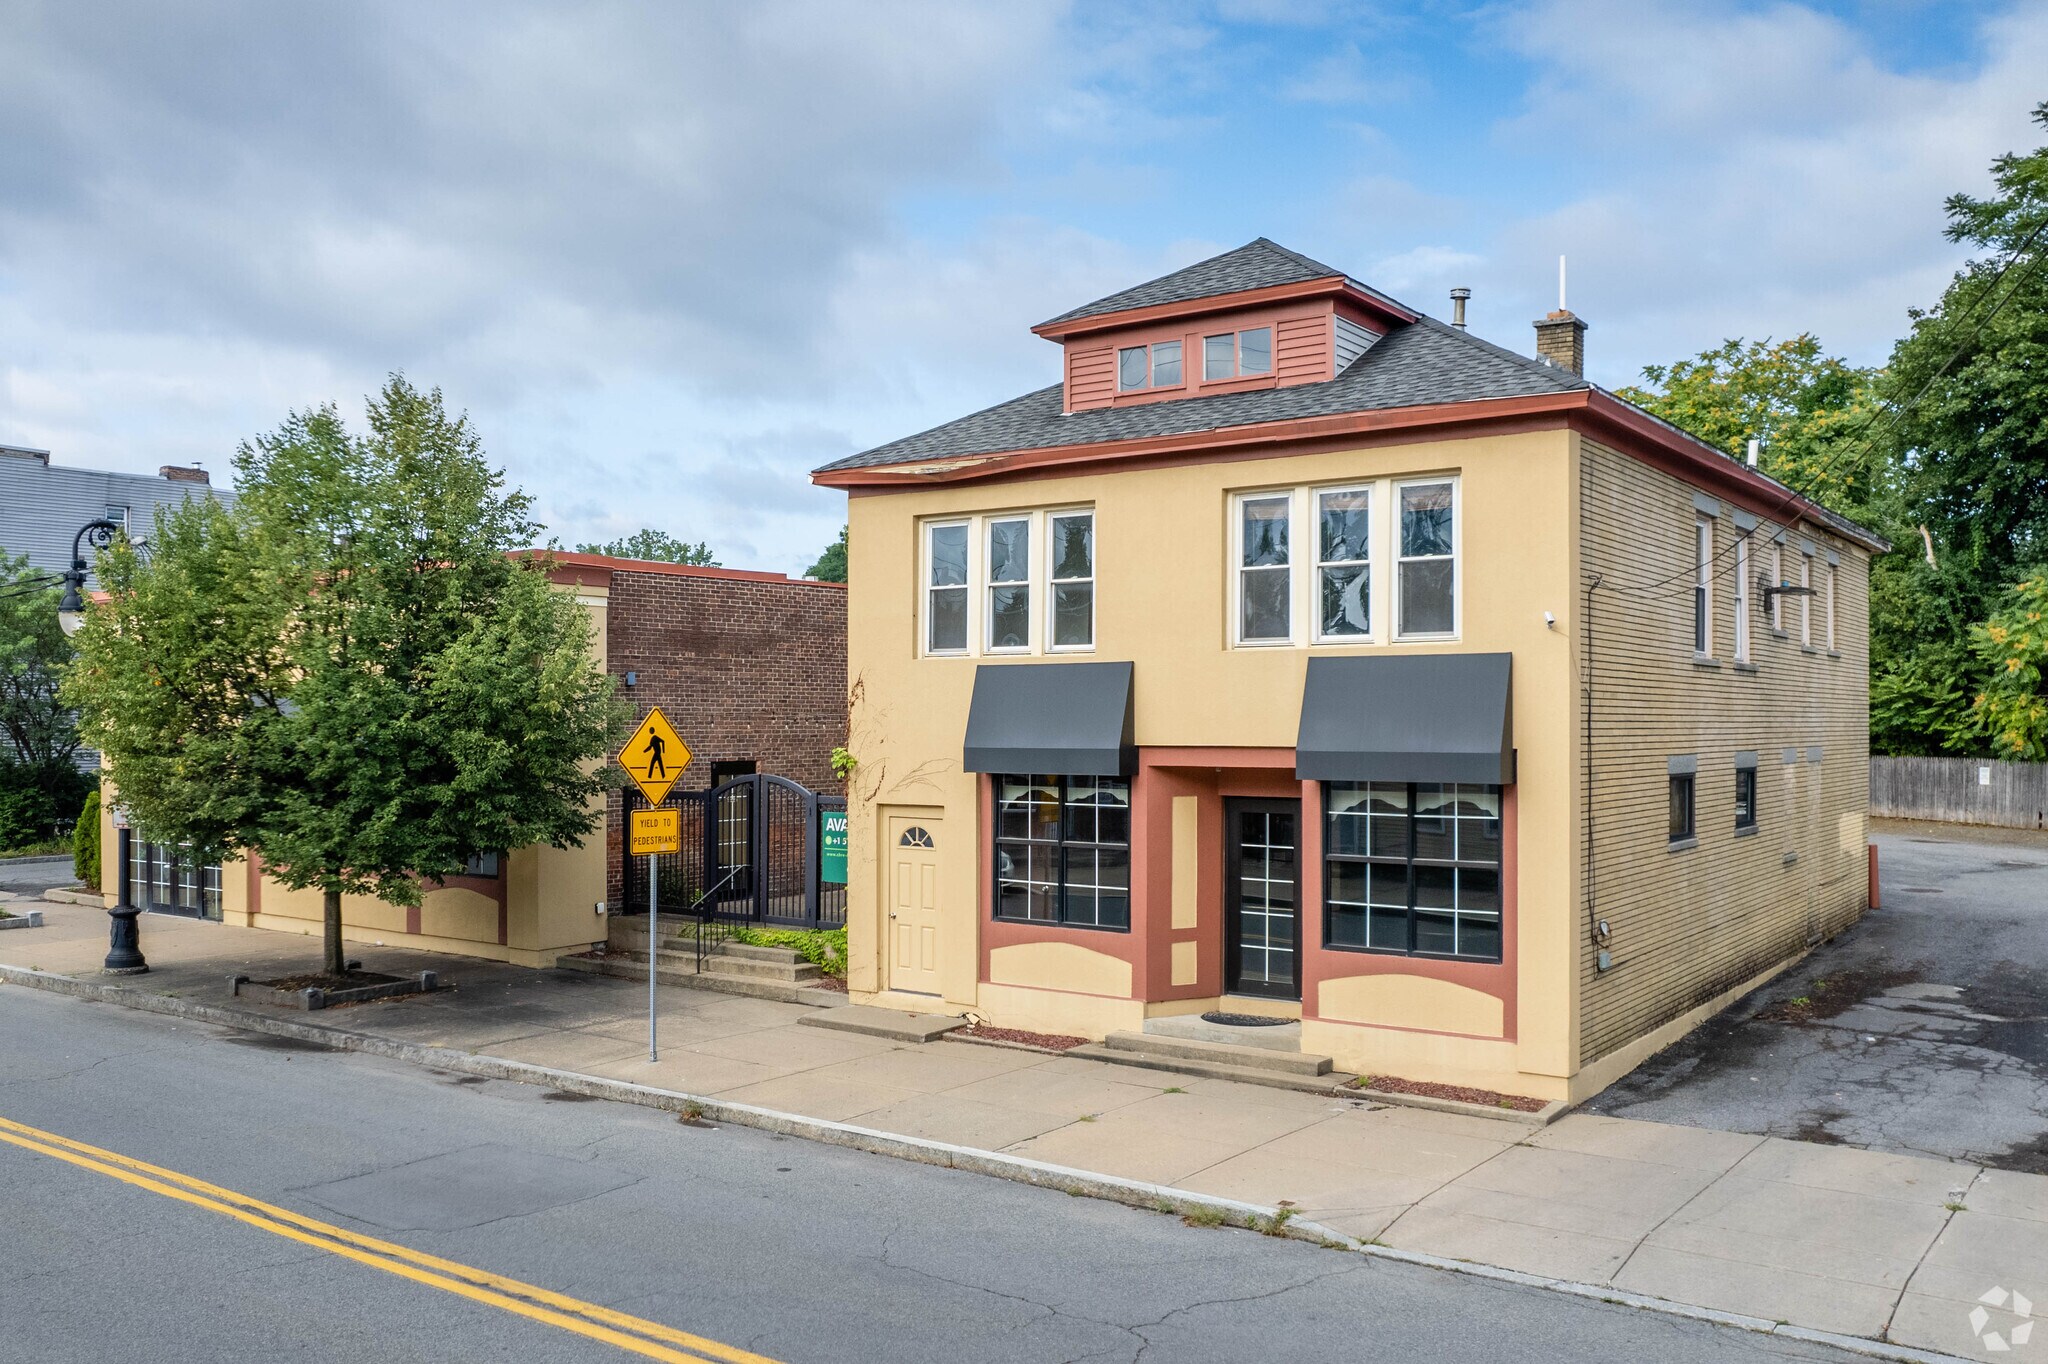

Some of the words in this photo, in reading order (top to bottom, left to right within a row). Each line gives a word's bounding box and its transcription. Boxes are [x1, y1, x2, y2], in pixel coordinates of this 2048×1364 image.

[640, 819, 658, 828] YIELD
[663, 818, 671, 827] TO
[633, 835, 677, 845] PEDESTRIANS
[842, 837, 848, 845] 5
